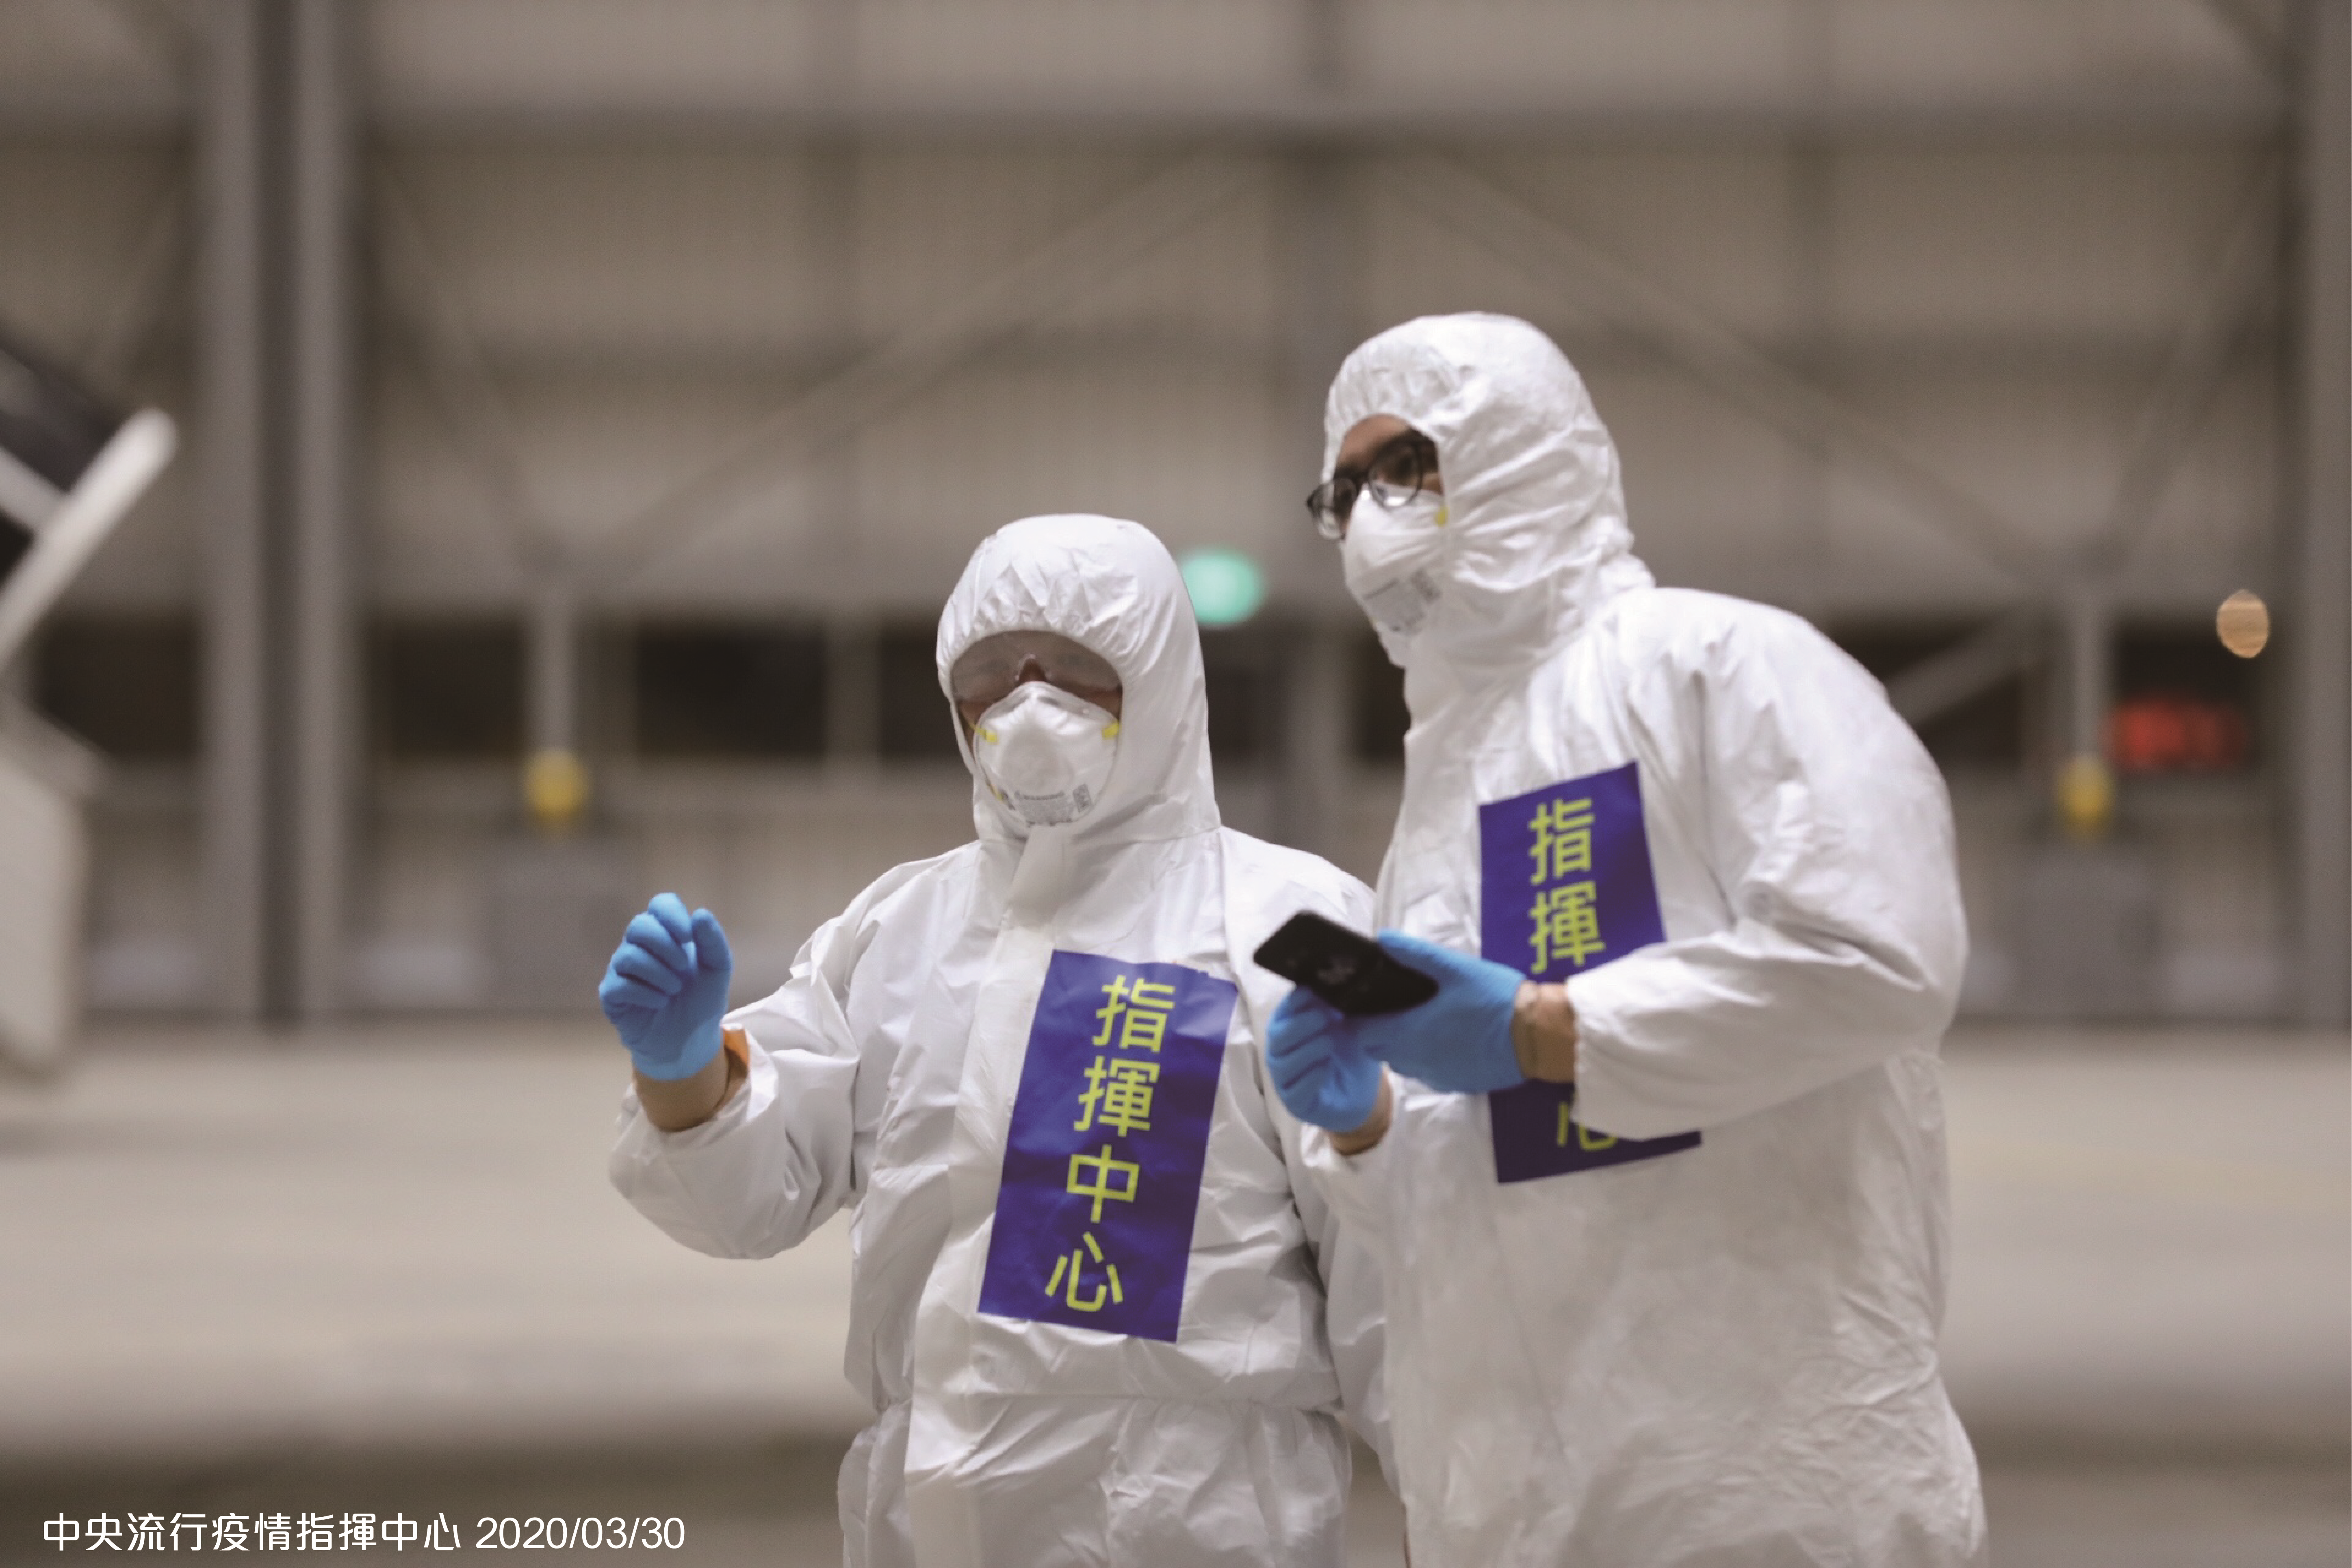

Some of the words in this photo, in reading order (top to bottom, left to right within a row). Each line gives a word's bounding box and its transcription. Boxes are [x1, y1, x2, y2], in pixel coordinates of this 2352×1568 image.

[1045, 976, 1175, 1312] 指揮中心
[1528, 798, 1618, 1150] 指揮
